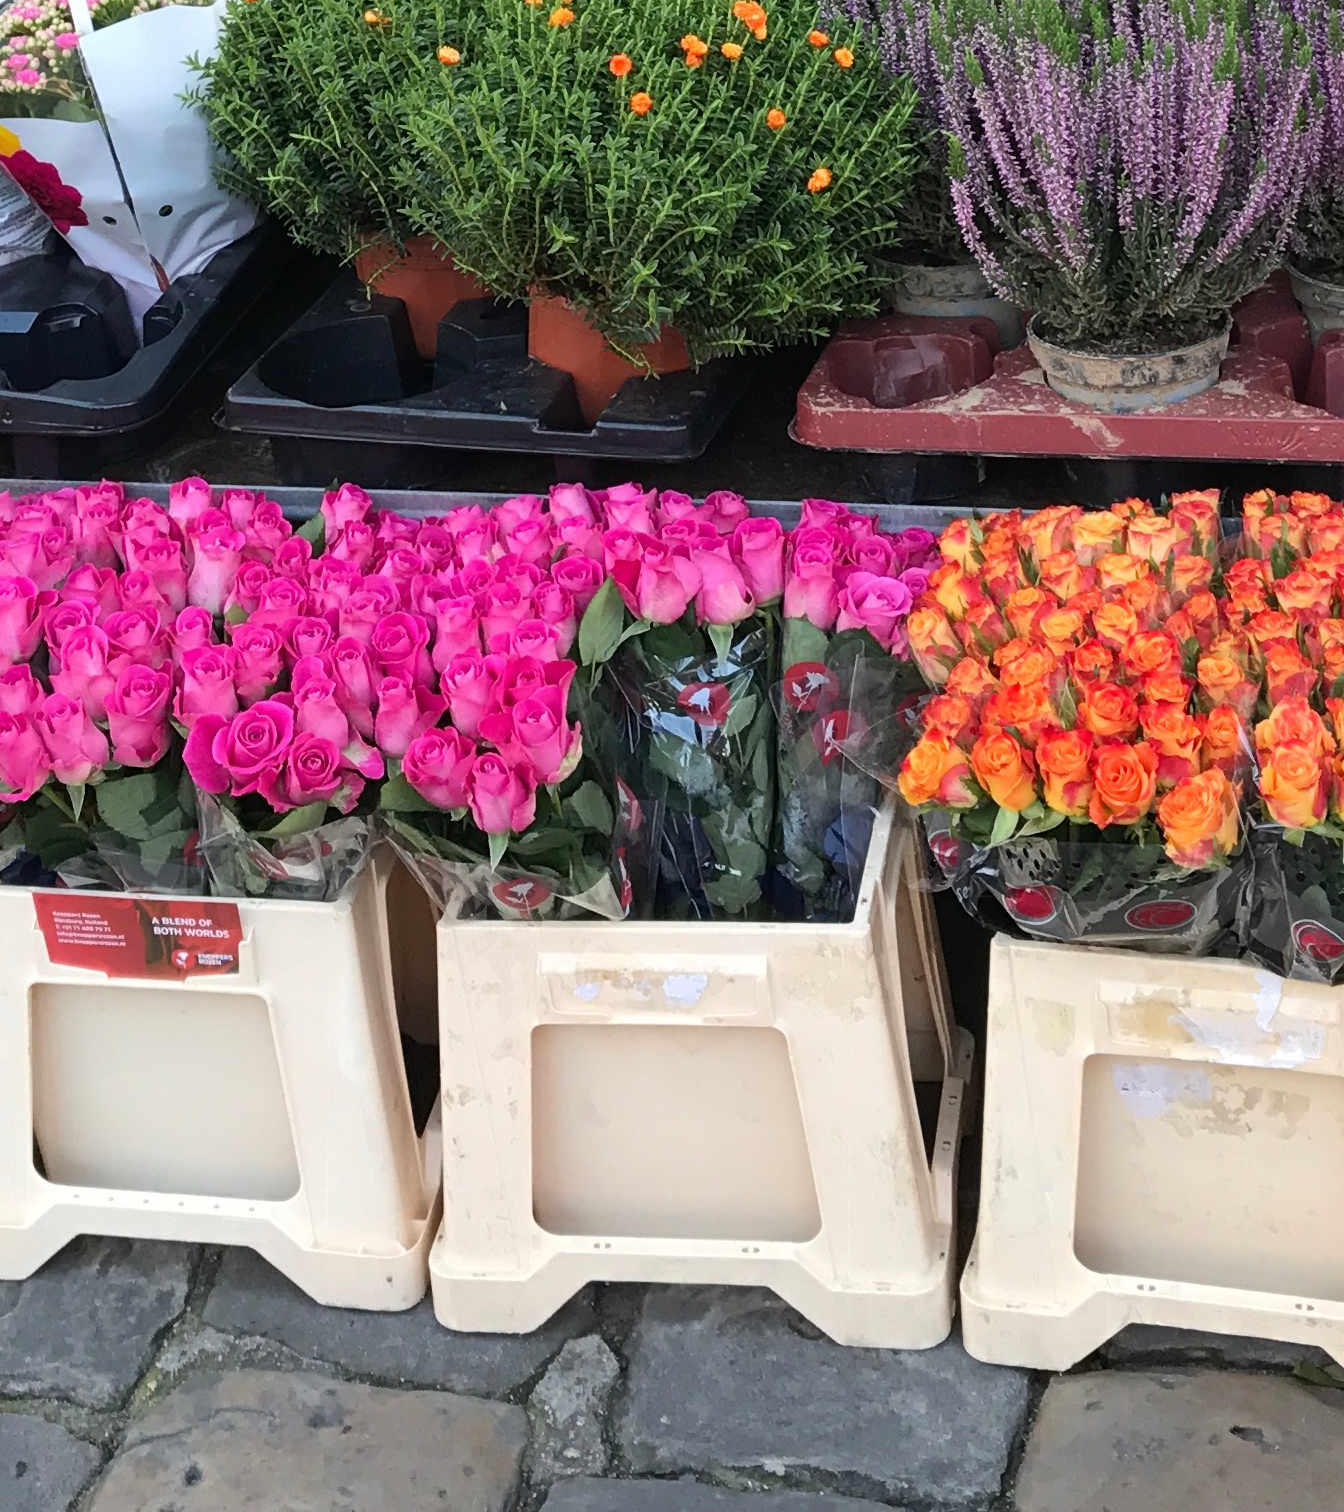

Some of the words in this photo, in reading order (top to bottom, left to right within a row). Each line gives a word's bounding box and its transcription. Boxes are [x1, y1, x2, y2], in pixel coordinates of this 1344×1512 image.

[151, 916, 159, 925] A
[162, 916, 196, 927] BLEND
[199, 919, 213, 928] OF
[153, 926, 182, 936] BOTH
[183, 928, 230, 939] WORLDS
